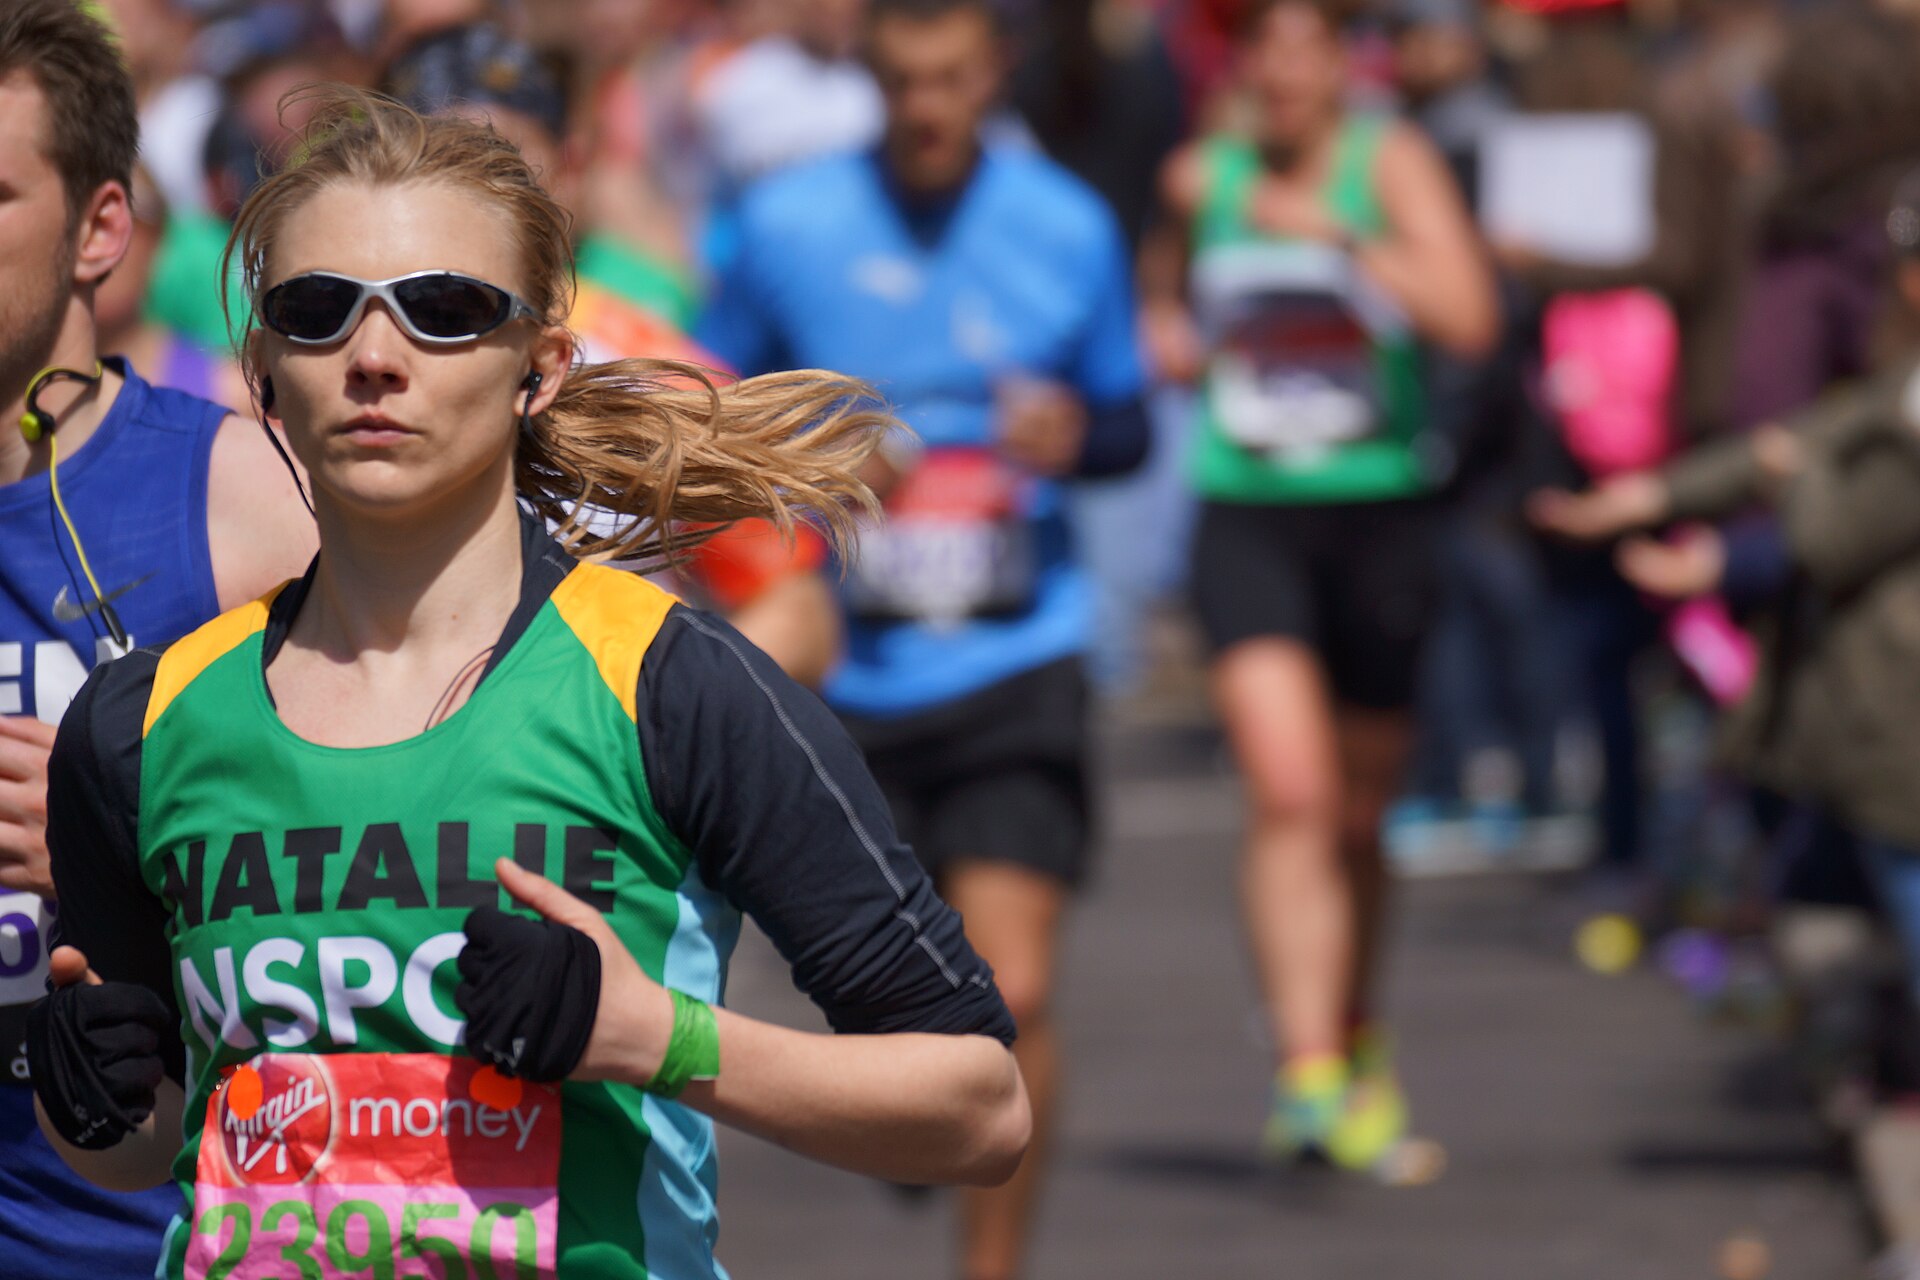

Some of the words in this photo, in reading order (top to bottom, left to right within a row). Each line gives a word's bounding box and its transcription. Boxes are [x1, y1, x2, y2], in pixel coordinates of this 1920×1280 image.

[163, 820, 621, 934] NATALIE
[350, 1096, 542, 1153] money
[197, 1199, 537, 1280] 23950
